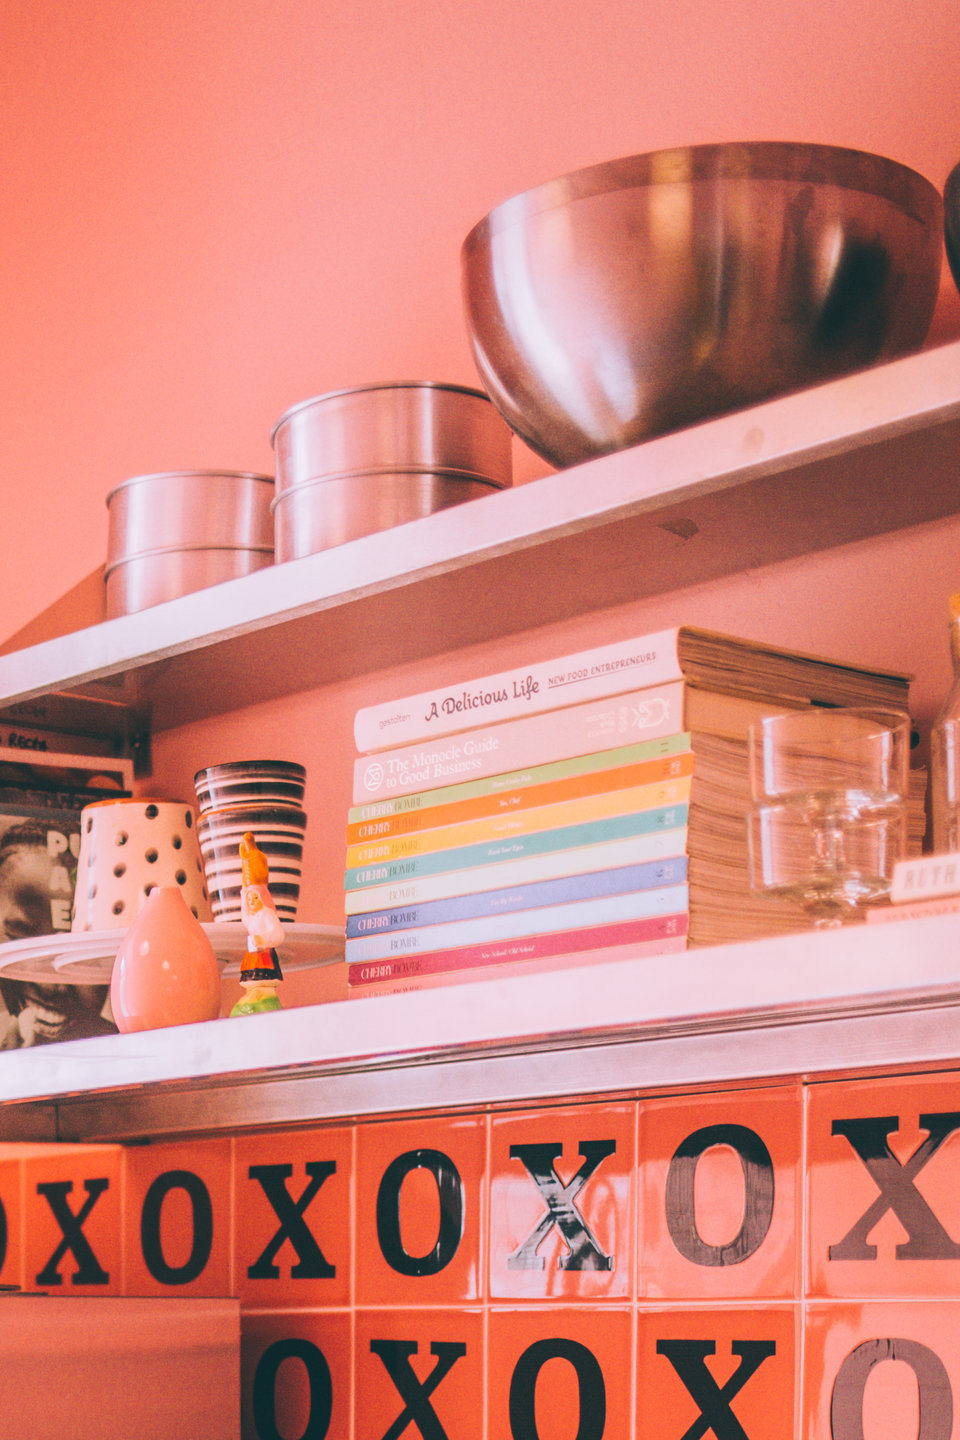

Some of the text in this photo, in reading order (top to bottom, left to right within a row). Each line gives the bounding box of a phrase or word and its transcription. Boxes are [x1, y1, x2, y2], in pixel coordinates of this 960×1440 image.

[425, 702, 439, 721] A
[442, 689, 508, 714] Delicious
[513, 675, 539, 700] Life
[547, 673, 565, 685] NEW
[567, 668, 589, 681] FOOD
[591, 651, 657, 674] ENTREPRENEURS
[386, 758, 483, 788] to Good Business
[387, 736, 500, 774] The Monocle Guide
